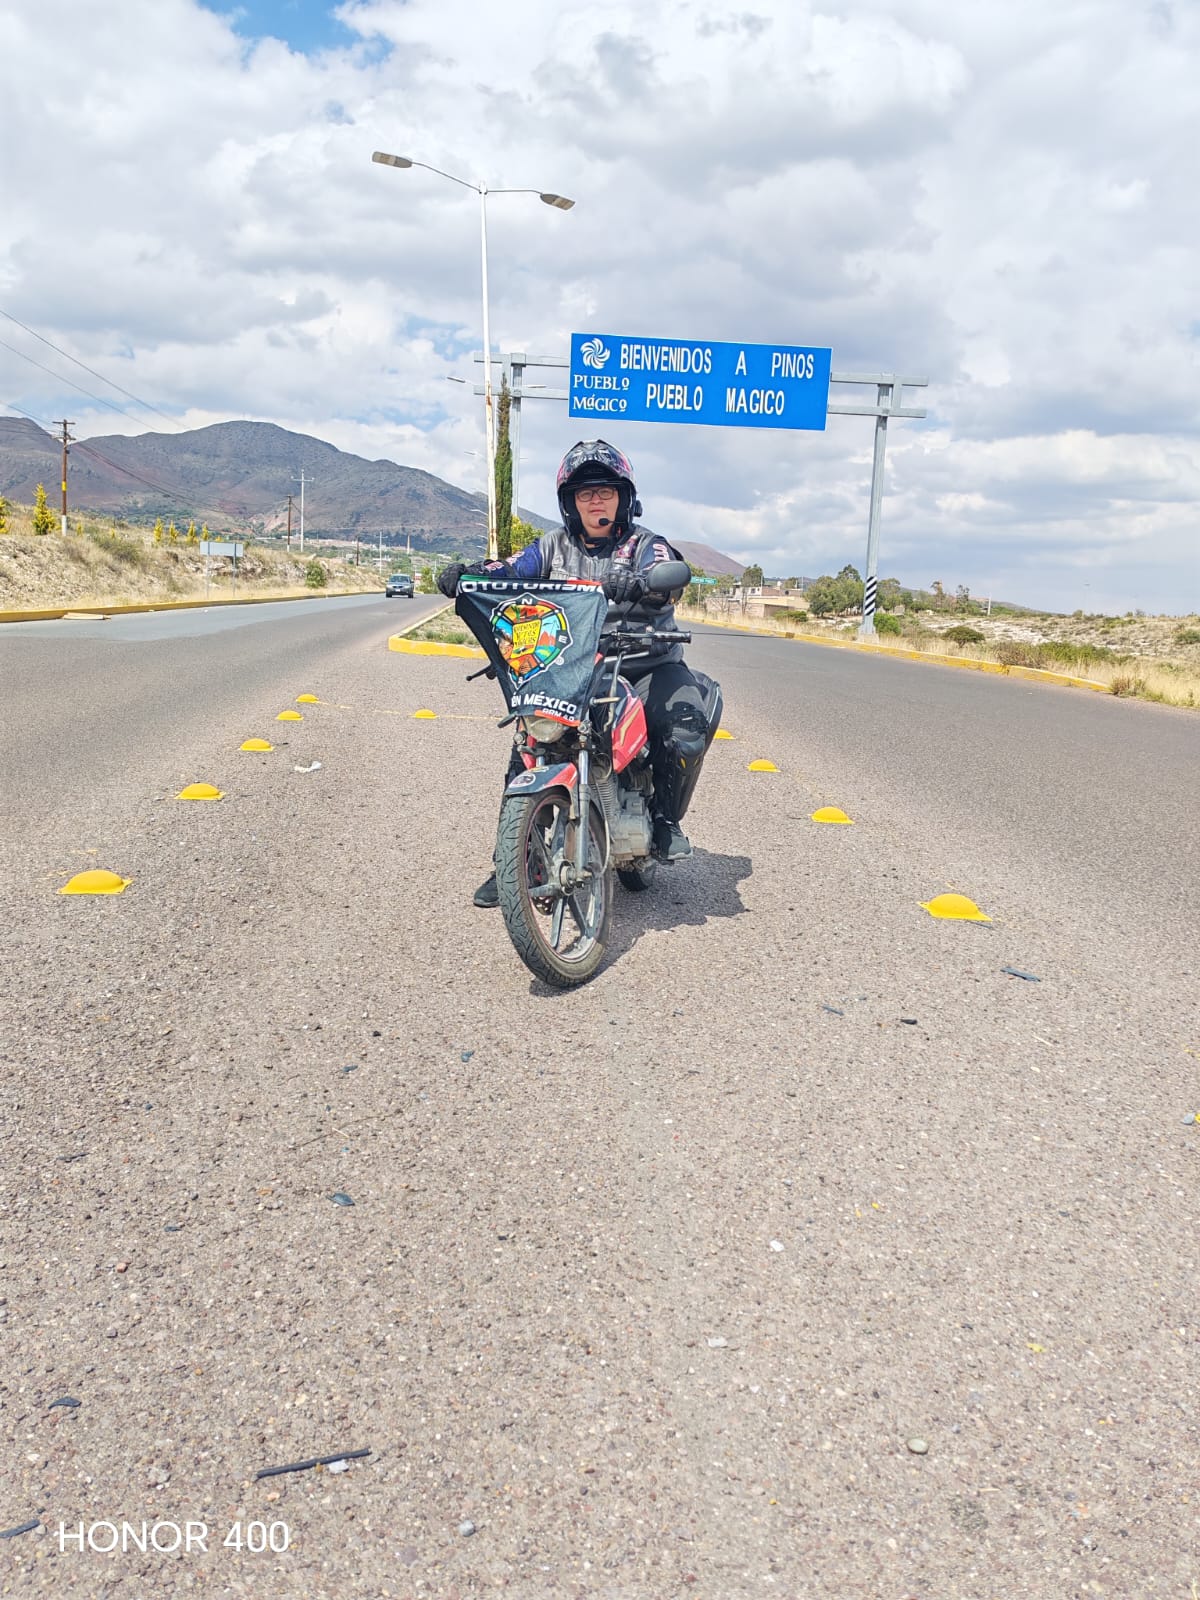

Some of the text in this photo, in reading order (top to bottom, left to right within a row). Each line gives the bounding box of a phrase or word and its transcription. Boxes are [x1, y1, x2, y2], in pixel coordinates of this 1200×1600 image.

[620, 343, 814, 379] BIENVENIDOS A PINOS
[646, 383, 785, 415] PUEBLO MAGICO
[523, 691, 577, 715] MÉXICO
